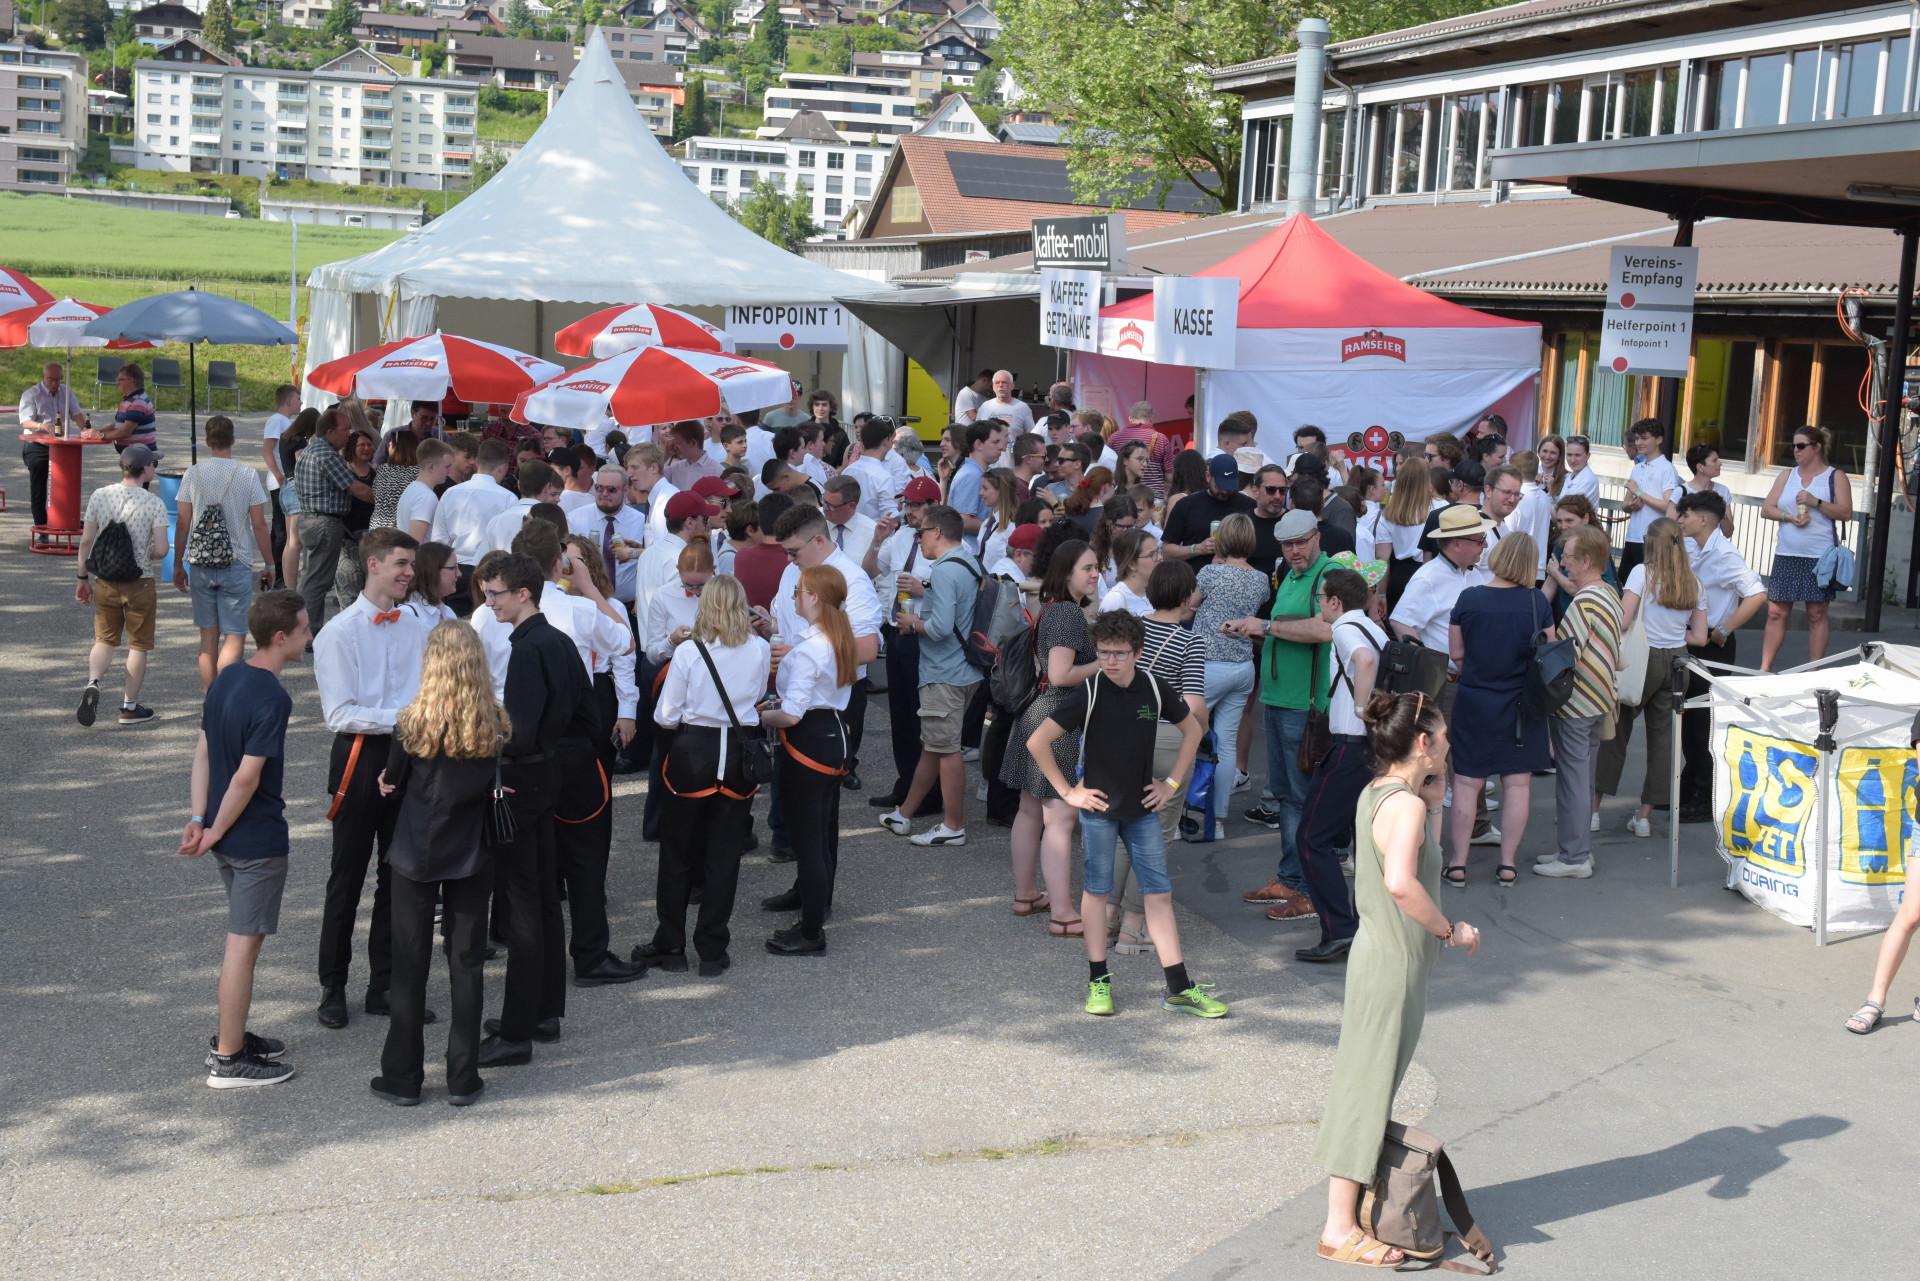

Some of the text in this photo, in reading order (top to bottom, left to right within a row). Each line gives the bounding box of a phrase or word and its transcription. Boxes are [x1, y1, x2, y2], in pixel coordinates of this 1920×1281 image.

[1034, 222, 1108, 258] kaffee-mobil
[1624, 255, 1683, 269] Vereins-
[1621, 271, 1684, 288] Empfang
[1050, 280, 1088, 306] KAFFEE-
[733, 305, 841, 325] INFOPOINT 1
[1046, 307, 1092, 340] GETRÄNKE
[1174, 308, 1214, 336] KASSE
[1607, 319, 1687, 333] Helferpoint 1
[1344, 340, 1403, 355] RAMSEIER
[1621, 338, 1669, 348] Infopoint 1
